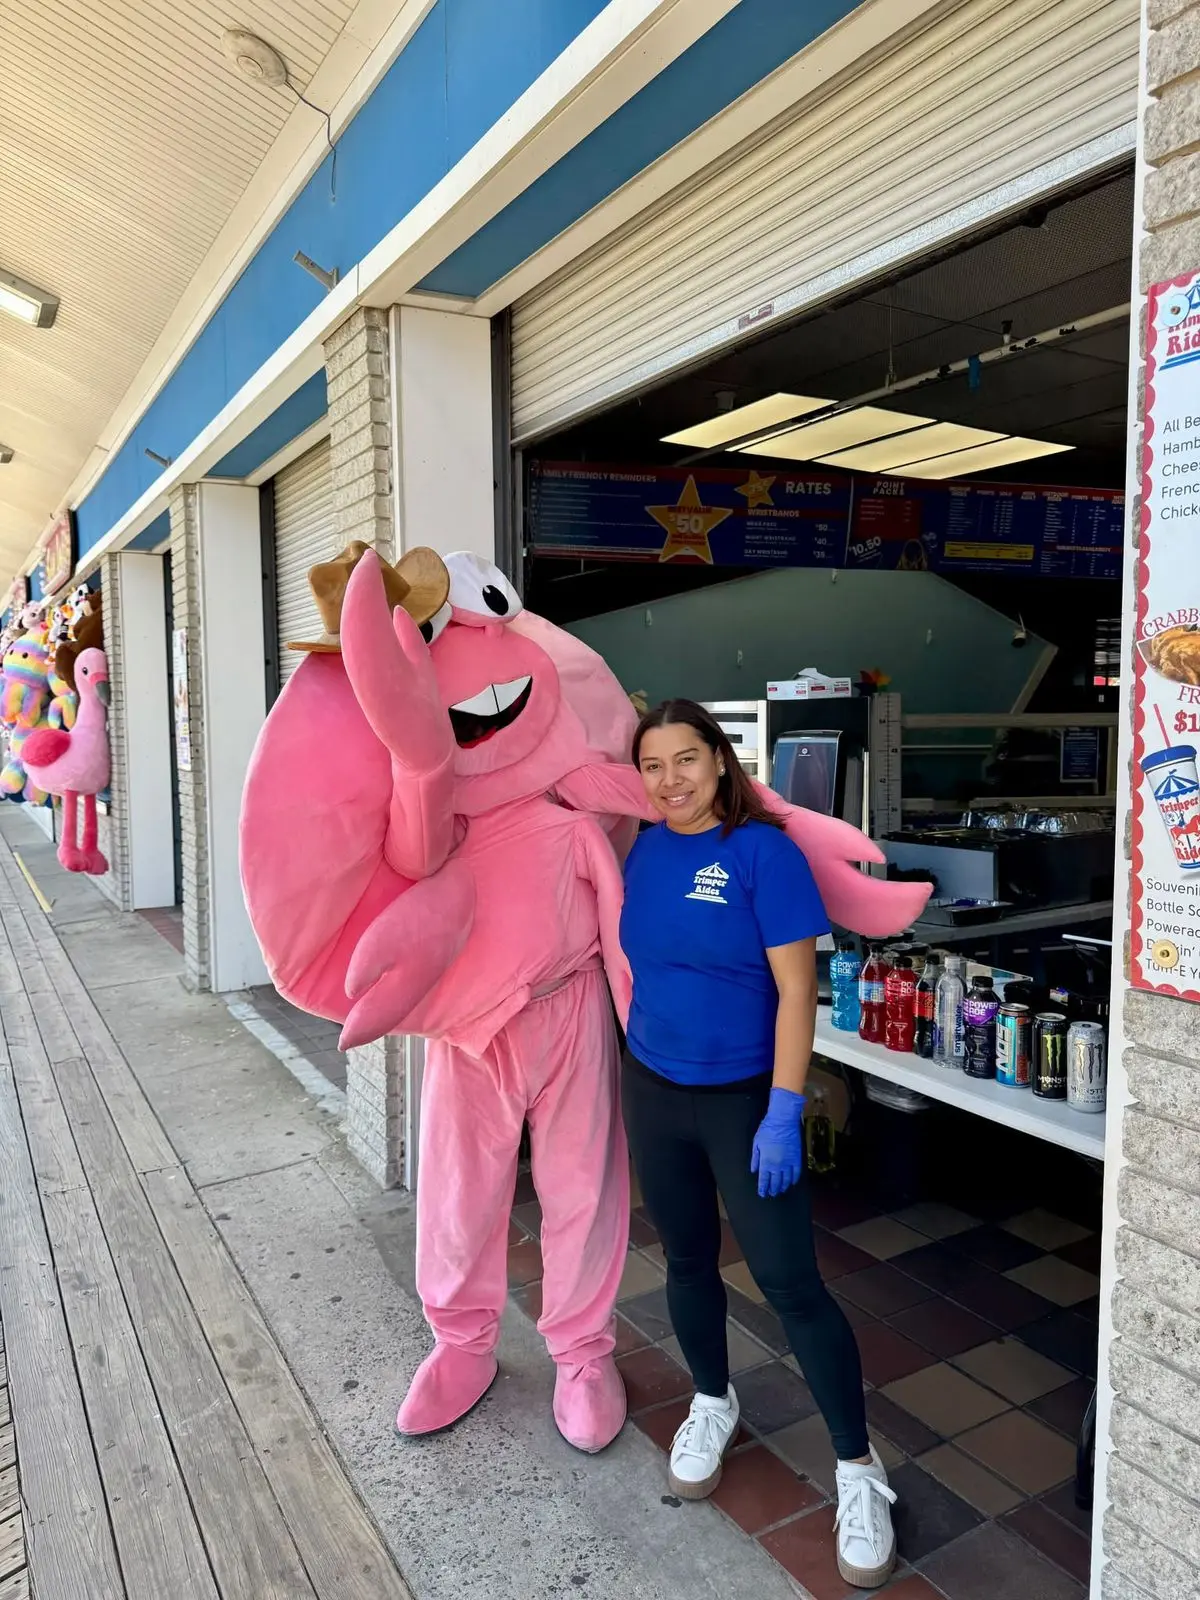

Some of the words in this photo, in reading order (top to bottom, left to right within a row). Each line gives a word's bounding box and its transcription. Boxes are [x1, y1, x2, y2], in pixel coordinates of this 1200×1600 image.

[1163, 419, 1179, 434] All
[569, 470, 608, 480] FRIENDLY
[610, 473, 657, 483] REMINDERS
[1162, 461, 1200, 477] Chee
[785, 481, 832, 495] RATES
[872, 488, 906, 496] PACKS
[876, 481, 906, 489] POINT
[747, 508, 801, 518] WRISTBANDS
[1160, 502, 1200, 520] Chick
[1143, 608, 1200, 638] CRABB
[1160, 796, 1199, 813] Trimper
[693, 875, 727, 887] Trimper
[1146, 877, 1200, 896] Souveni
[695, 884, 720, 896] Rides
[1146, 898, 1184, 914] Bottle
[954, 1004, 964, 1053] smartwater
